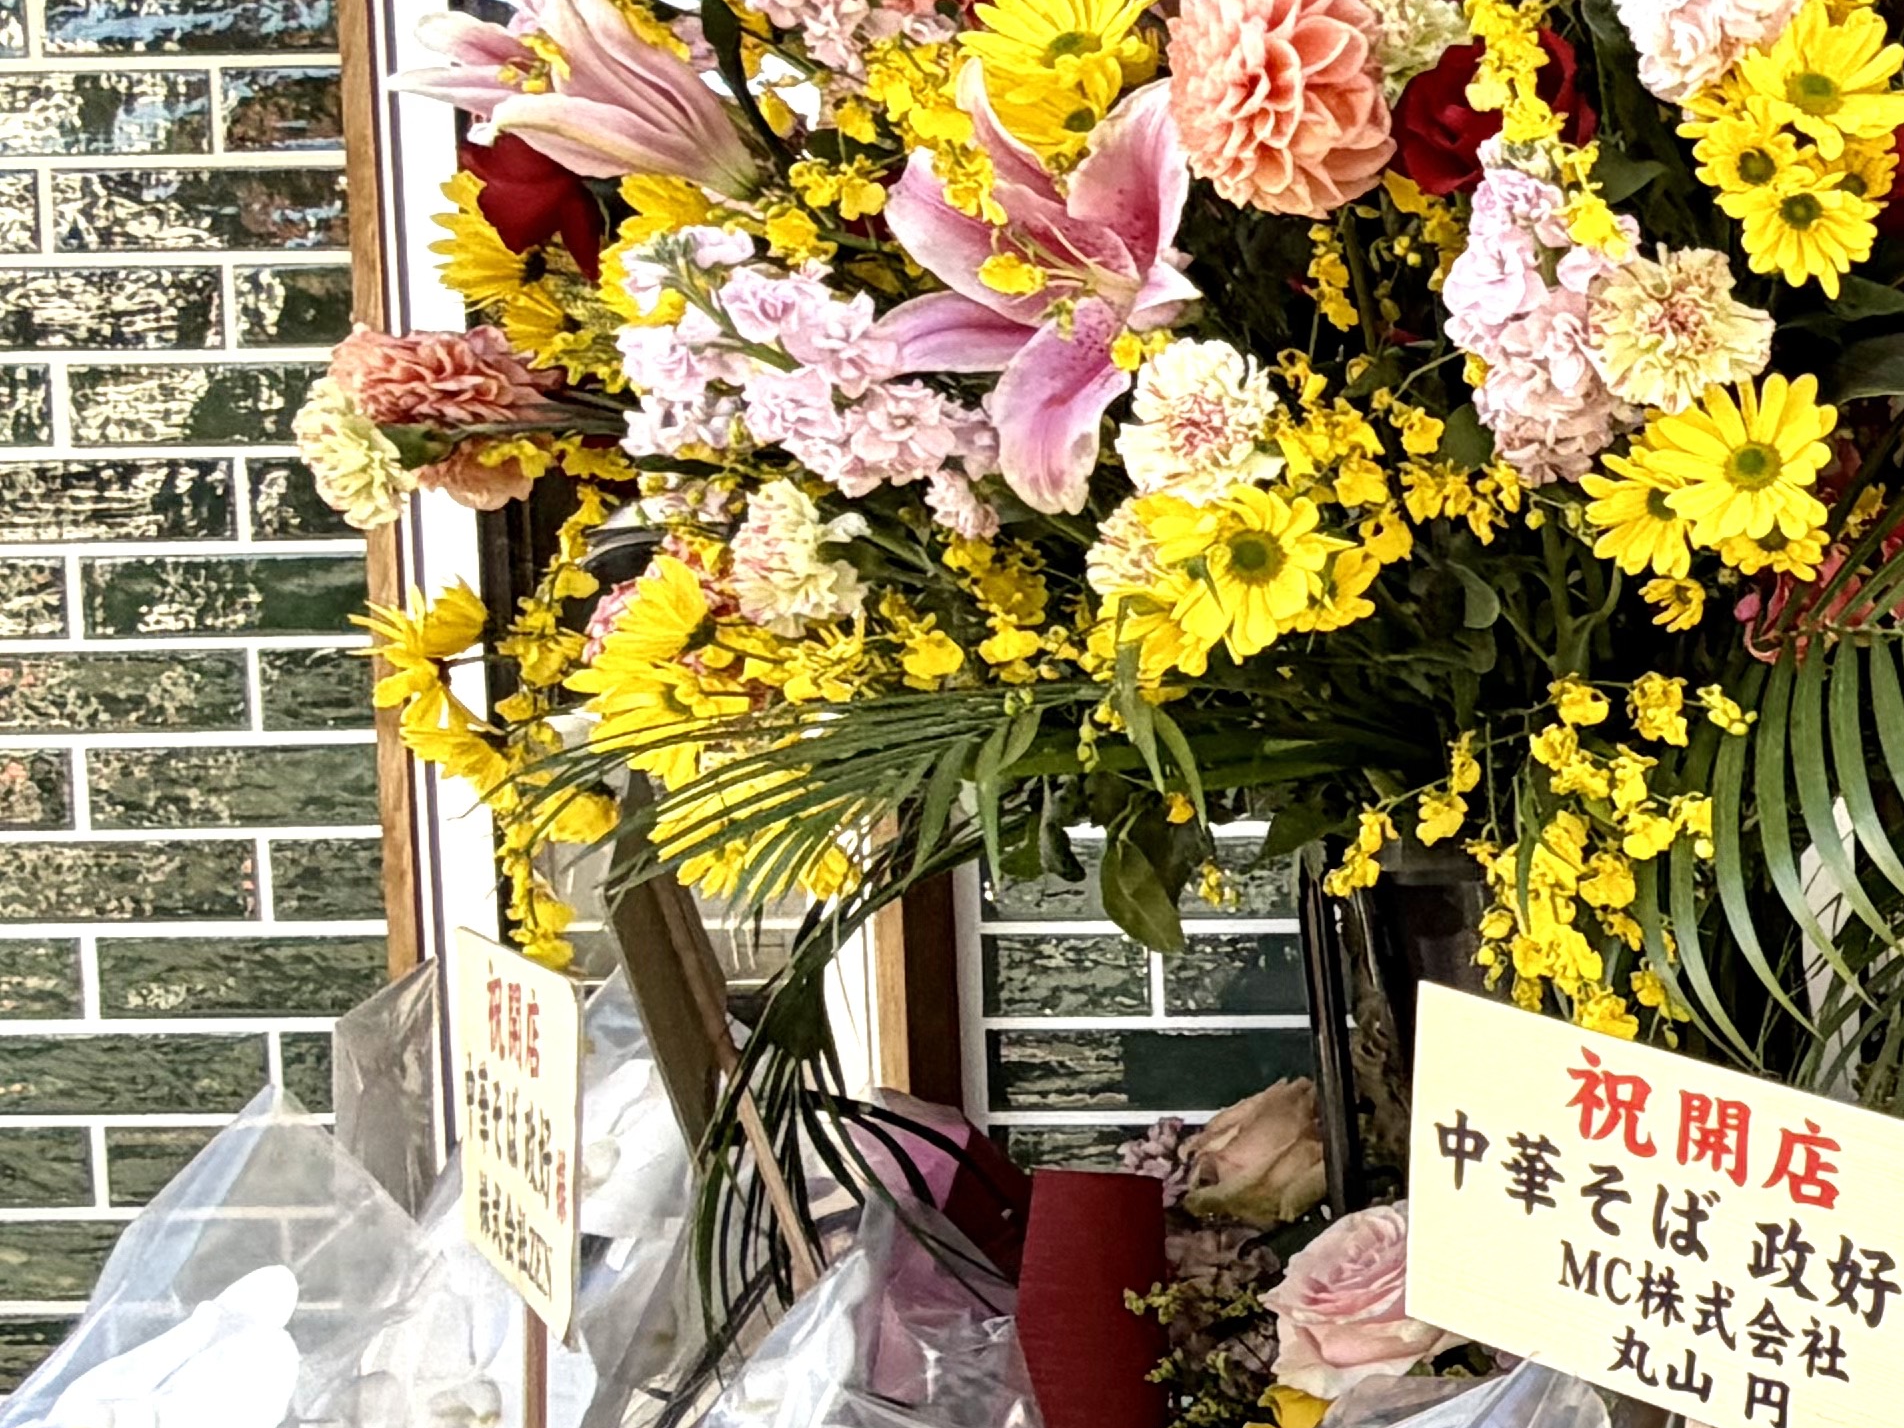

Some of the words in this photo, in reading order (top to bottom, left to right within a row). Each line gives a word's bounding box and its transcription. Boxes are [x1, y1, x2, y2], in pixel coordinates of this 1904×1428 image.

[1565, 1045, 1843, 1211] 祝開店
[1558, 1239, 1851, 1384] MC株式会社
